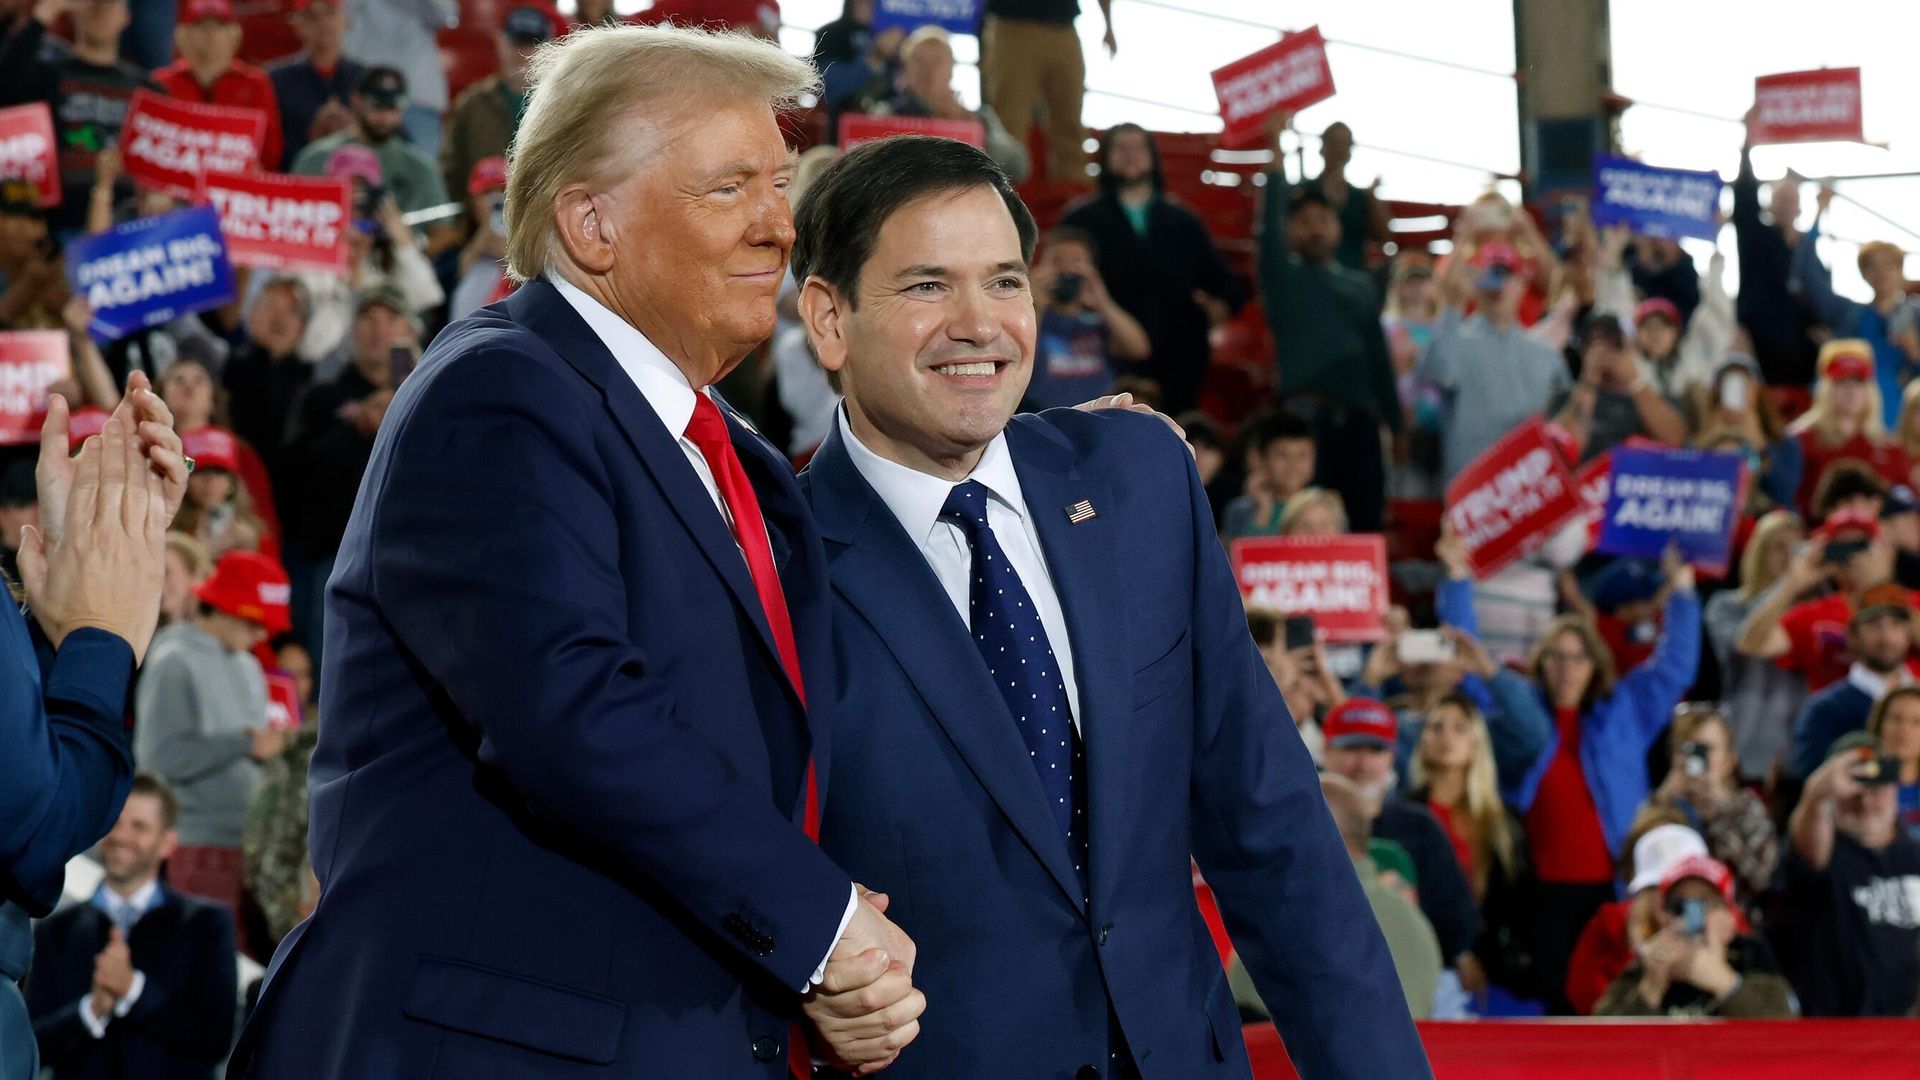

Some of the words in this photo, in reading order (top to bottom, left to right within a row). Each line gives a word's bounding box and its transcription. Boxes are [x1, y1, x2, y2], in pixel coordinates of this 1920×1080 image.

[131, 111, 214, 148] DREAM
[208, 187, 342, 223] TRUMP
[78, 244, 167, 286] DREAM
[167, 233, 222, 263] BIG,
[88, 258, 216, 309] AGAIN!
[1451, 447, 1551, 533] TRUMP
[1615, 473, 1694, 498] DREAM
[1612, 498, 1725, 533] AGAIN!
[1241, 561, 1328, 583] DREAM
[1331, 561, 1382, 585] BIG,
[1250, 583, 1371, 613] AGAIN!
